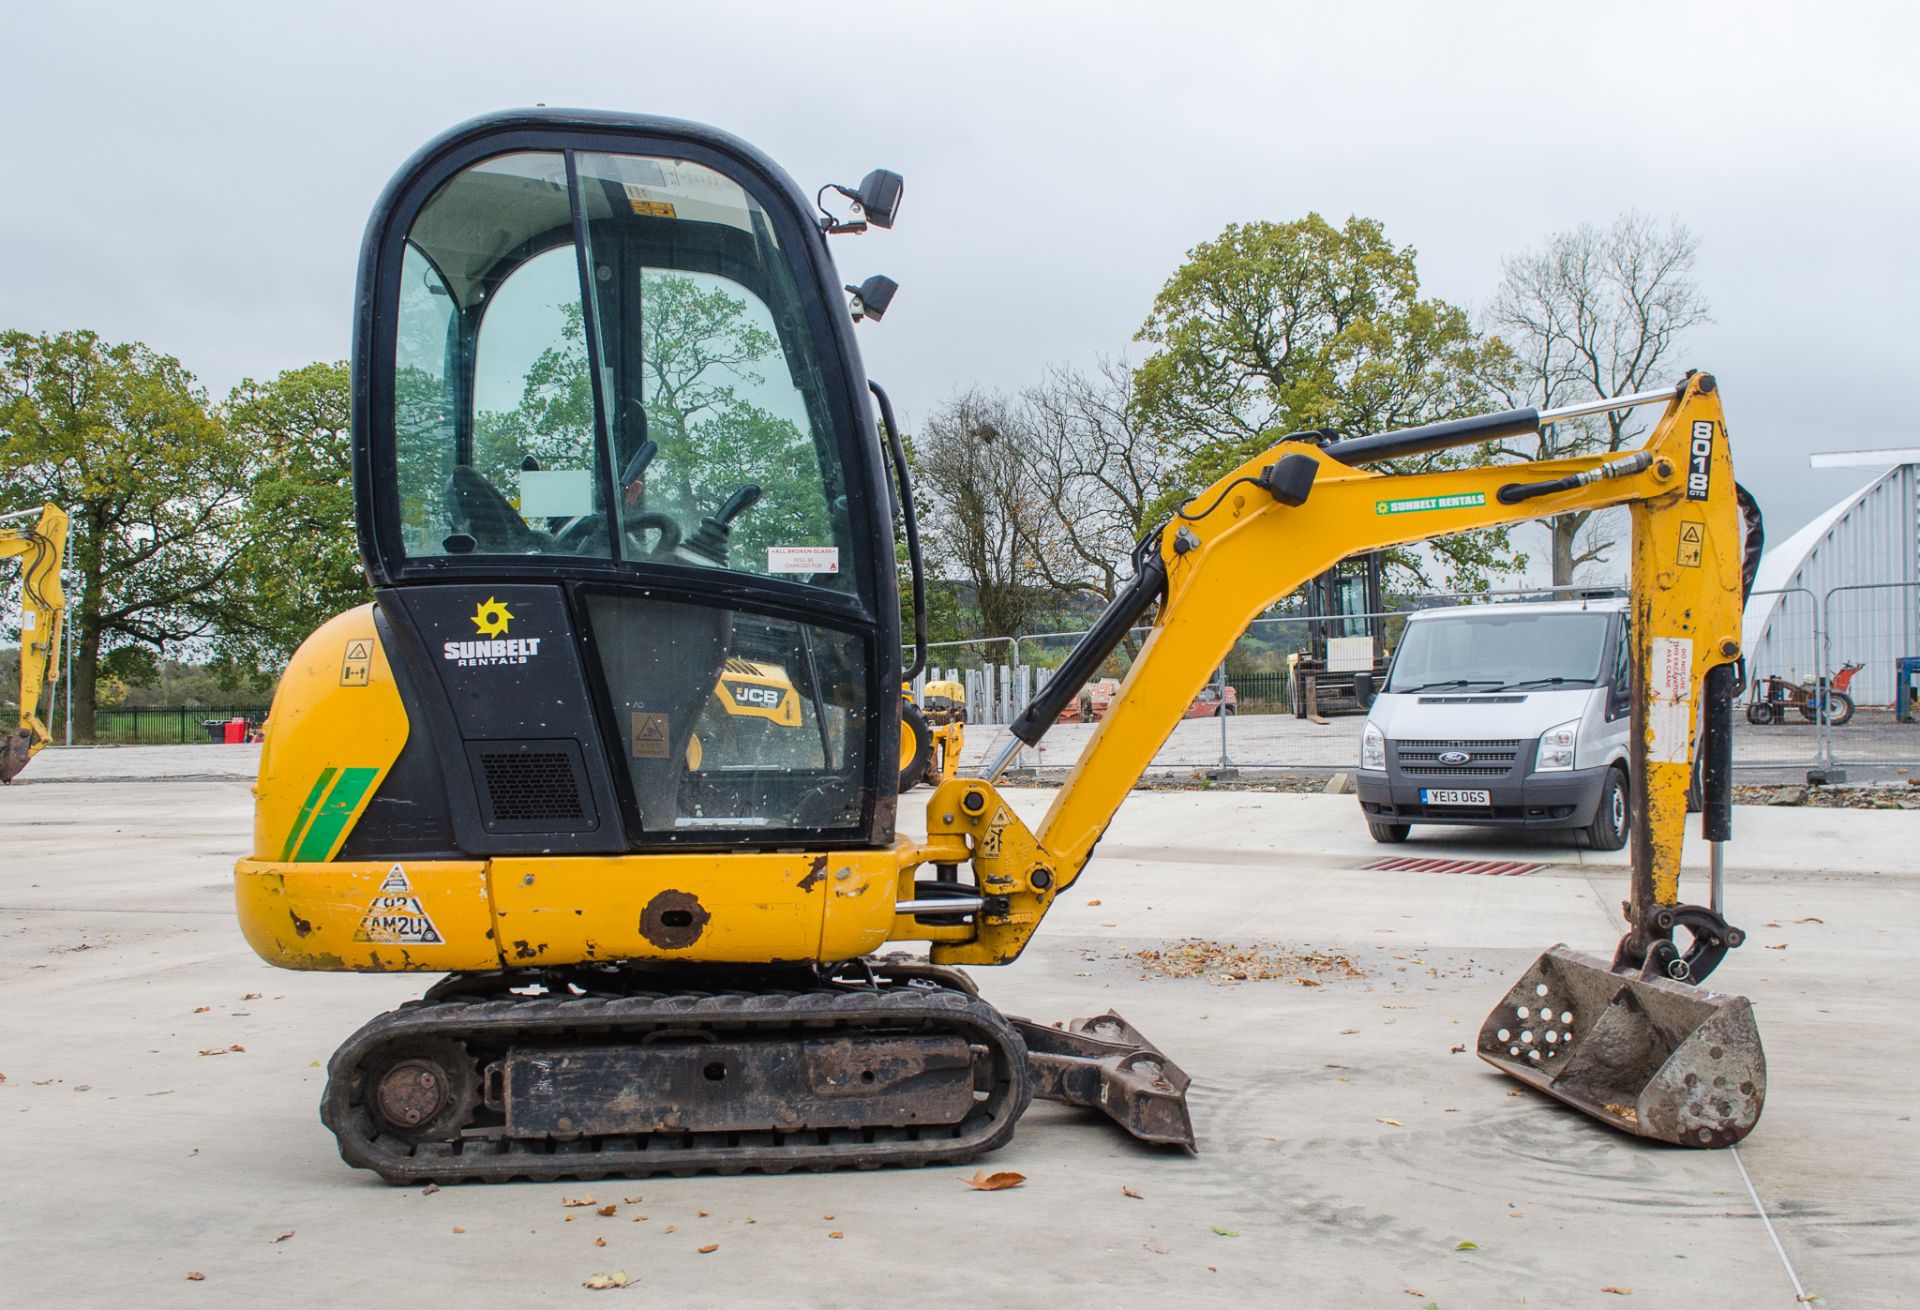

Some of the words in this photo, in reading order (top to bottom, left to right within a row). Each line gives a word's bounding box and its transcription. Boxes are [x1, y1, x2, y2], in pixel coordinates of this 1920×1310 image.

[1689, 421, 1712, 490] 8018
[1390, 499, 1436, 512] SUNBELT
[1438, 494, 1485, 507] RENTALS
[444, 638, 541, 660] SUNBELT
[1666, 648, 1672, 658] AS
[1681, 648, 1687, 659] DO
[458, 656, 528, 667] RENTALS
[736, 687, 779, 704] JCB
[1431, 791, 1458, 803] YE13
